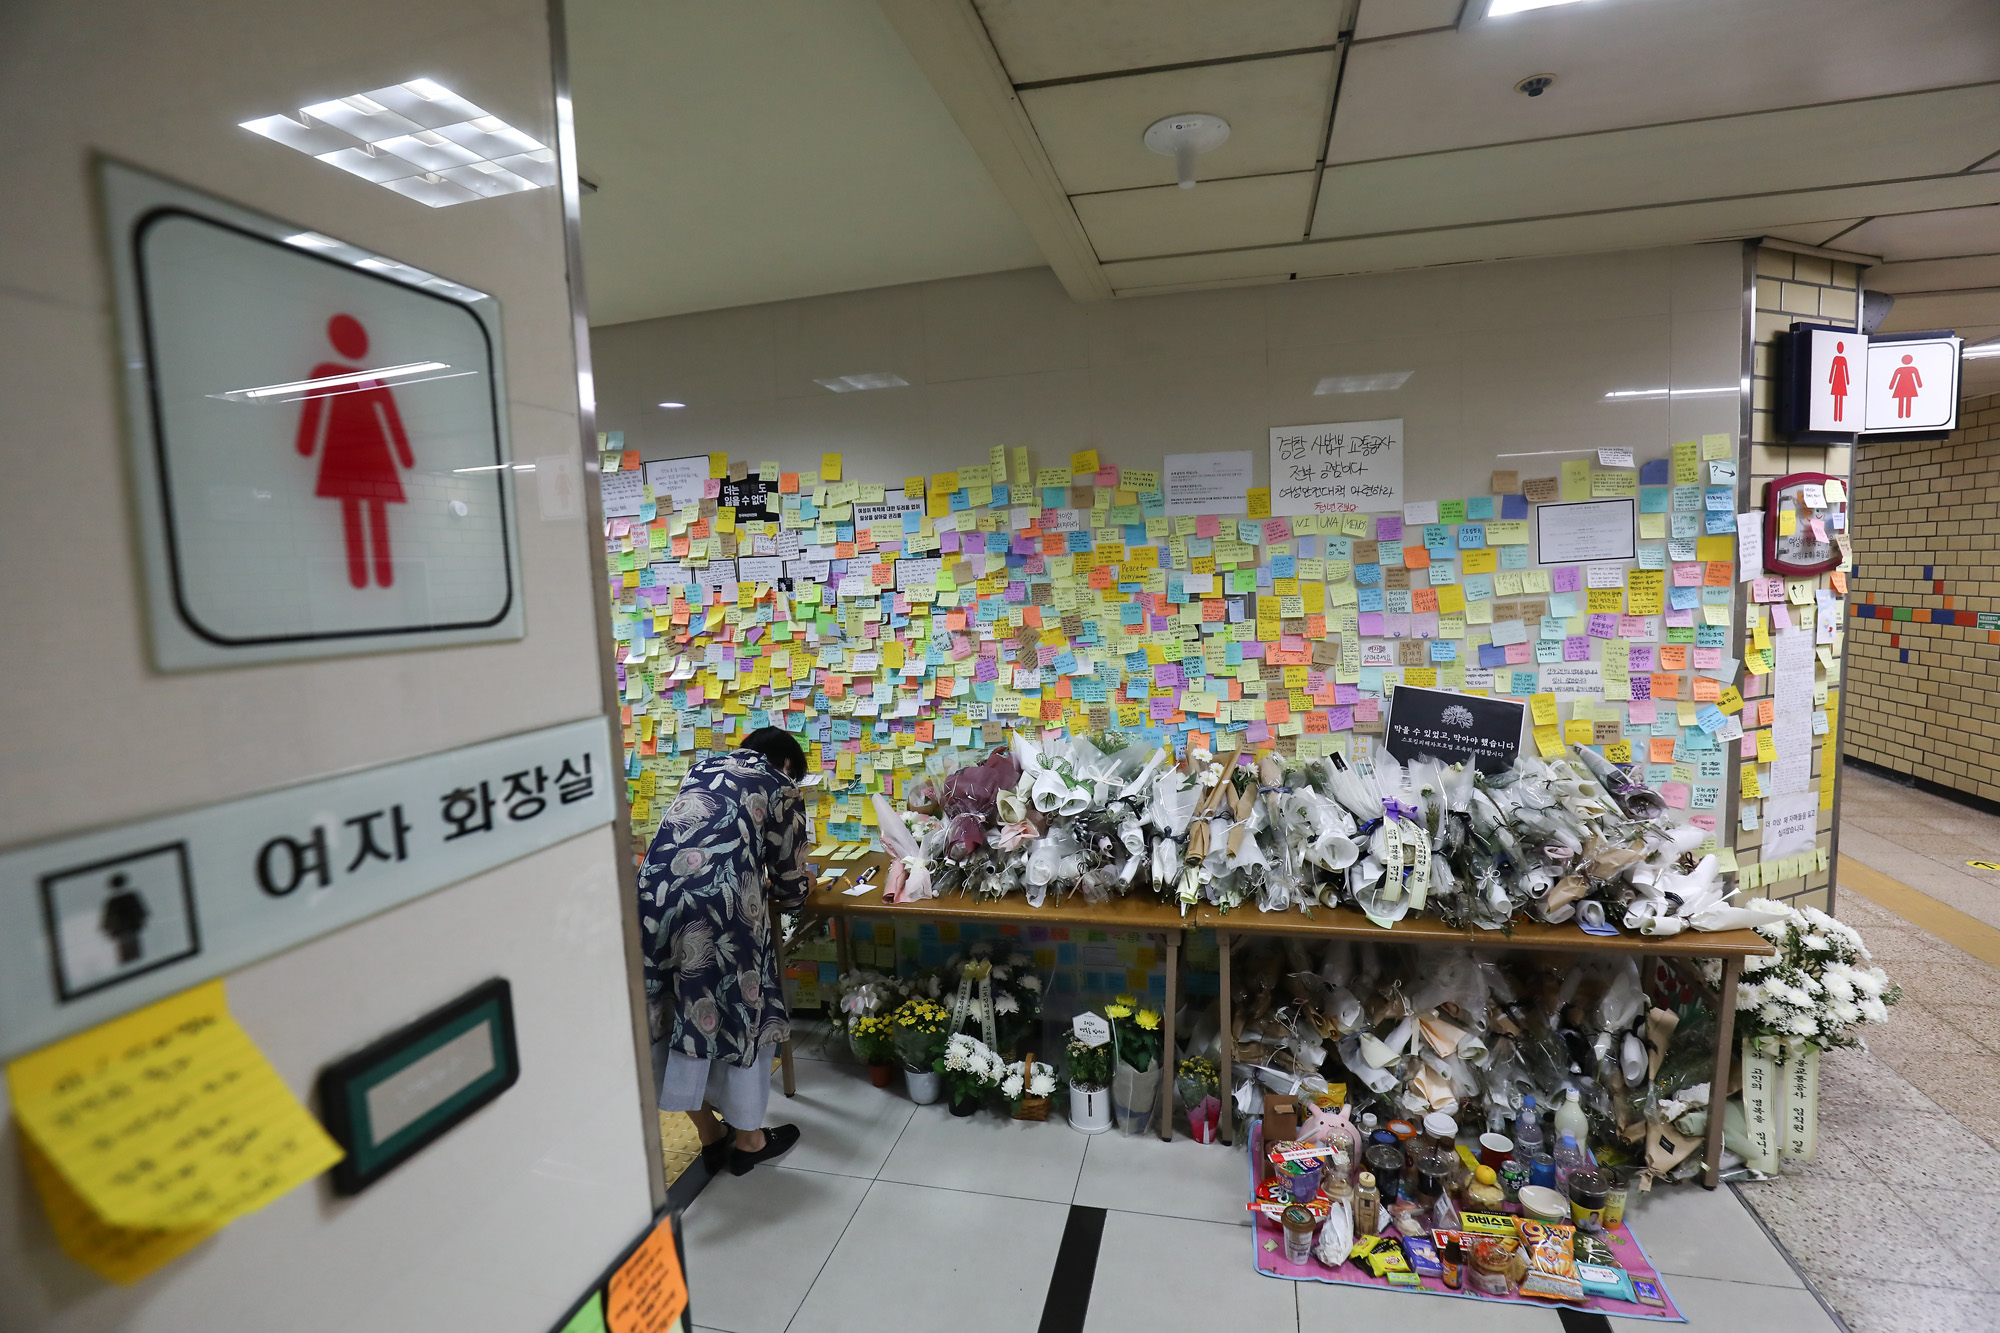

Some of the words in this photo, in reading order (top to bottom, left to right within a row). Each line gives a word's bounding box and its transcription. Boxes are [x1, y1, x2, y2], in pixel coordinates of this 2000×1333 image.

[1277, 436, 1307, 459] 경찰
[1348, 435, 1397, 457] 교통공사
[1290, 464, 1316, 481] 전부
[724, 485, 739, 495] 더는
[1279, 485, 1346, 499] 여성안전대책
[1351, 485, 1394, 498] 마련하라
[724, 495, 740, 506] 잃을
[741, 495, 750, 506] 수
[751, 494, 767, 505] 없다
[1314, 502, 1360, 514] 청년진보당
[1295, 518, 1310, 528] NI
[1320, 516, 1339, 529] UNA
[1121, 563, 1139, 572] Peace
[1140, 563, 1148, 571] for
[1394, 724, 1410, 735] 막을
[1412, 728, 1421, 736] 수
[1424, 729, 1451, 740] 있었고,
[1453, 733, 1478, 745] 막아야
[1481, 738, 1515, 751] 했습니다
[257, 804, 412, 897] 여자
[442, 753, 594, 841] 화장실
[1466, 1214, 1514, 1227] 하비스트
